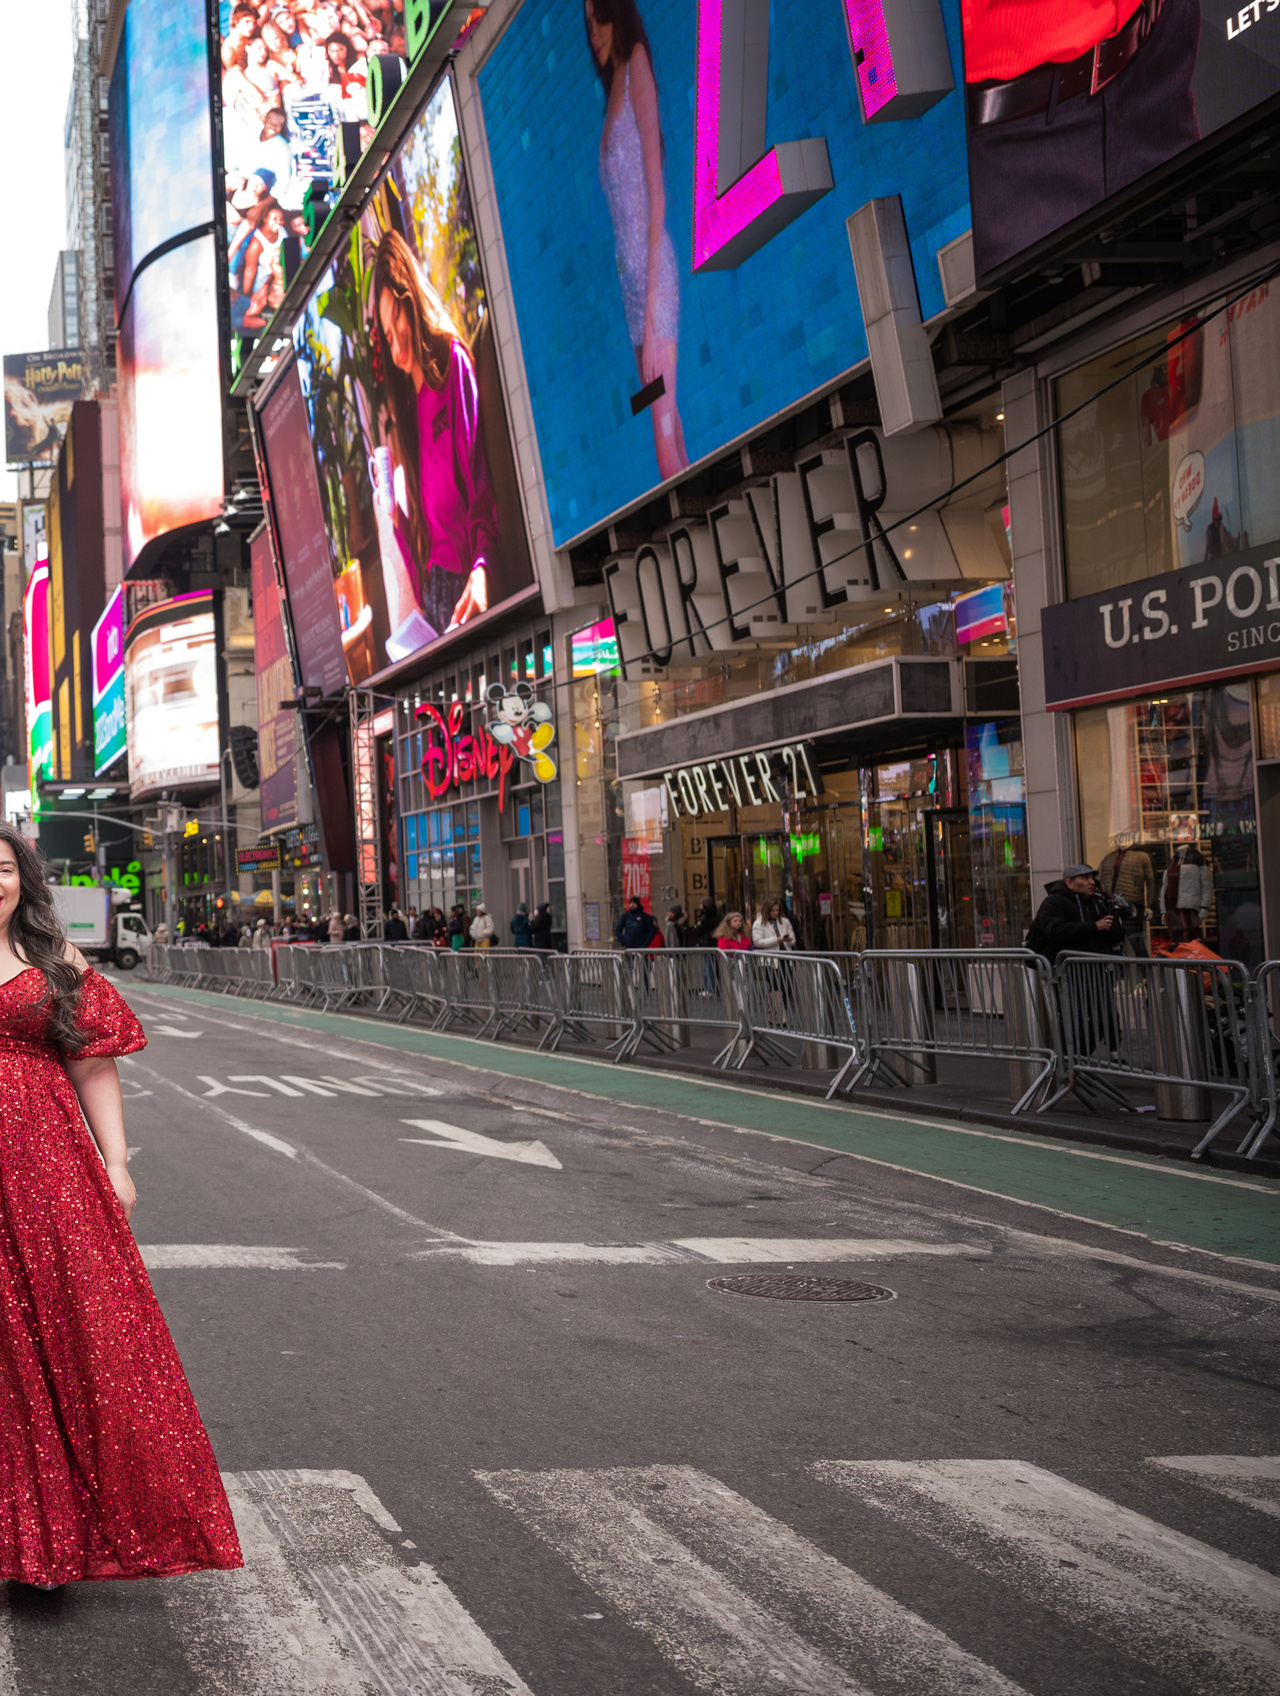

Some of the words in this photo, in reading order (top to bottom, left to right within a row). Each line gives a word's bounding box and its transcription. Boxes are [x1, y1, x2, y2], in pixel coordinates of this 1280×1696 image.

[57, 361, 93, 383] Pott
[1099, 589, 1179, 649] U.S.
[664, 752, 782, 819] FOREVER
[782, 744, 818, 800] 21
[238, 848, 278, 863] ELECTRONICS
[196, 1074, 446, 1098] ONLY
